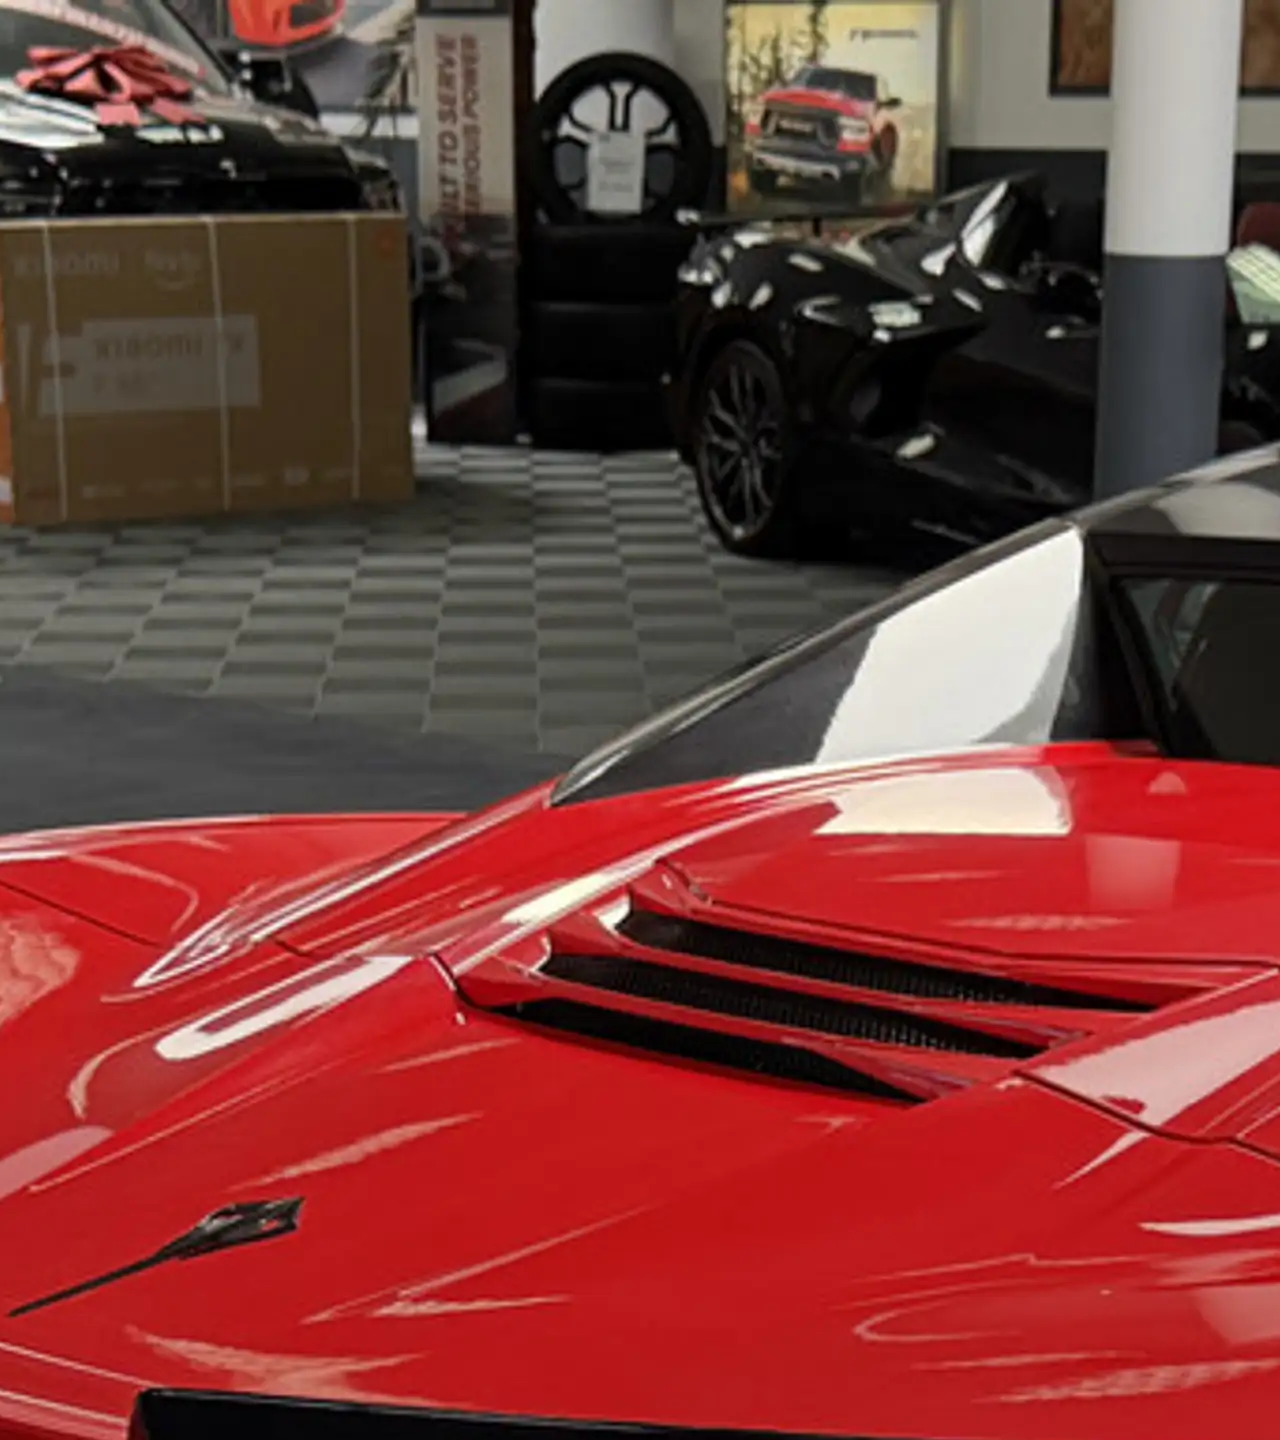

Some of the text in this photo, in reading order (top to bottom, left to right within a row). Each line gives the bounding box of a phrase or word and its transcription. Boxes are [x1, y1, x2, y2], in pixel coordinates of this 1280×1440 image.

[436, 33, 458, 125] SERVE
[460, 33, 480, 120] POWER
[437, 130, 459, 167] TO
